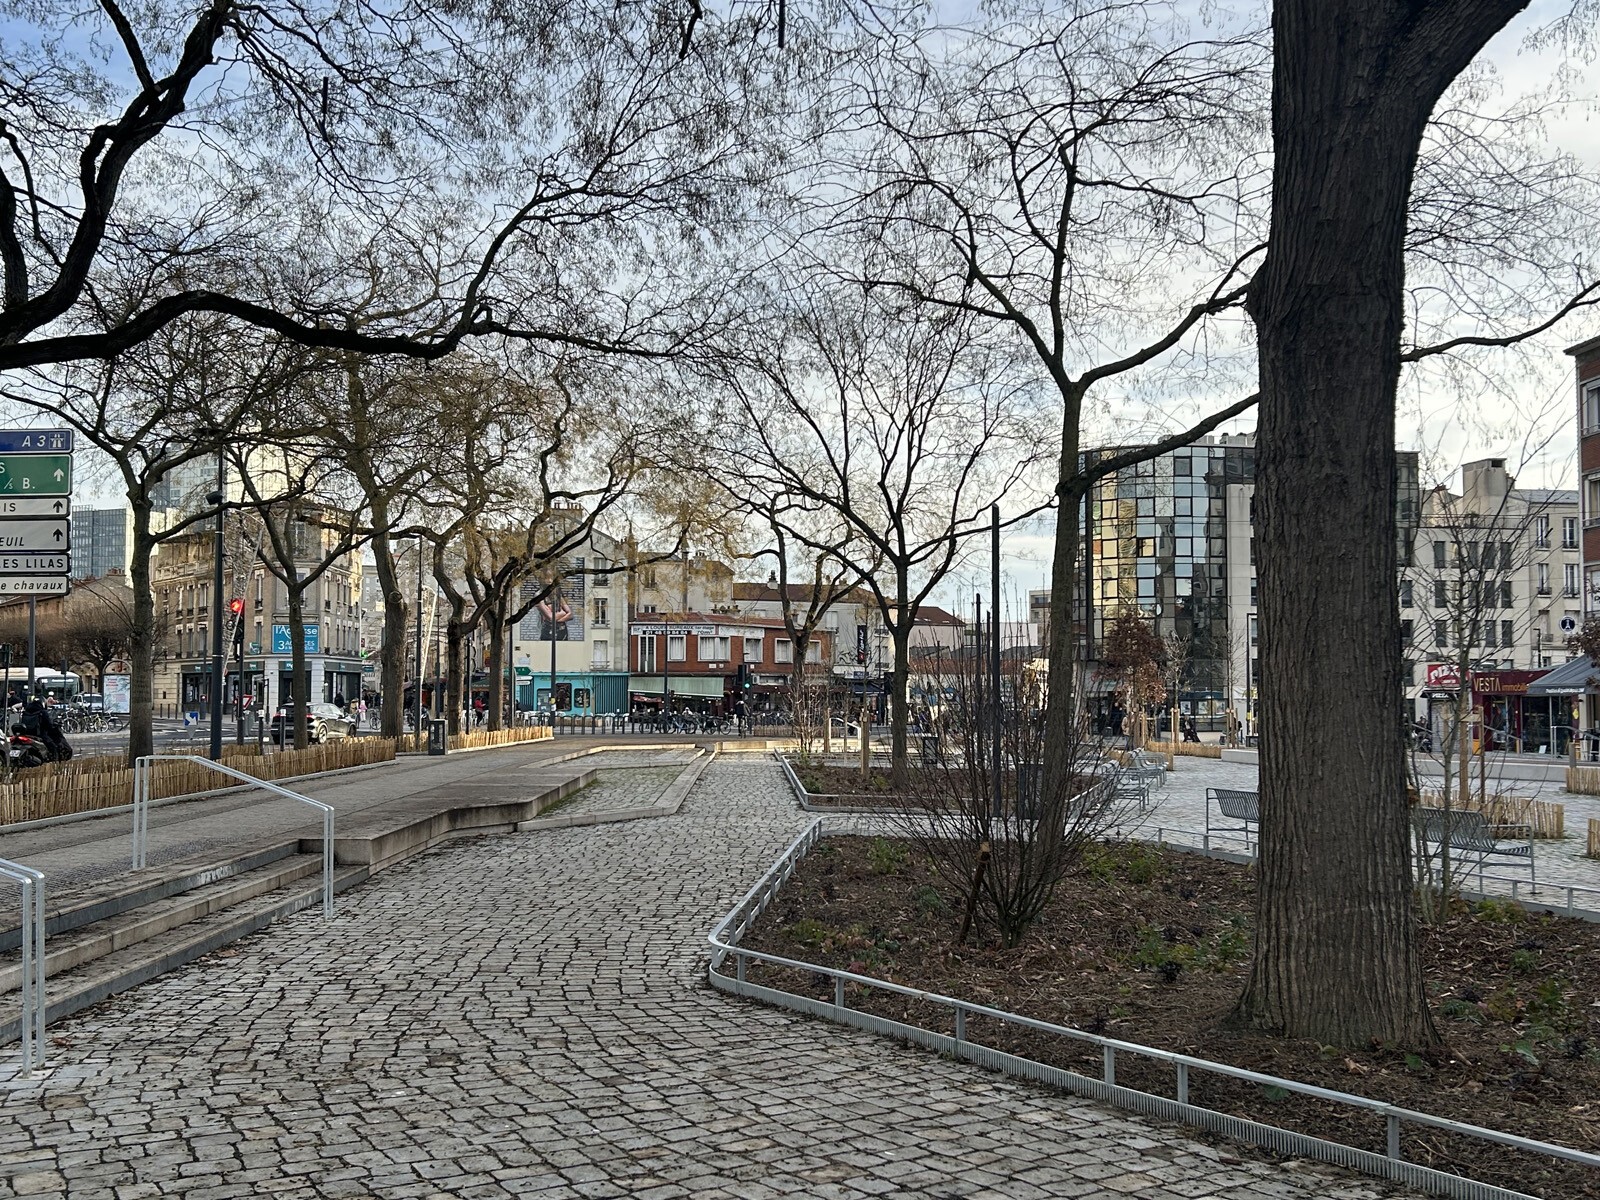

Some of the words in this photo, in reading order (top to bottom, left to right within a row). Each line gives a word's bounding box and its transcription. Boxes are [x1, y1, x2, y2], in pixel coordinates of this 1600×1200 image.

[22, 435, 31, 447] A
[37, 435, 46, 447] 3
[26, 558, 64, 568] LILAS
[14, 580, 63, 590] chavaux
[277, 640, 285, 650] 3
[1473, 677, 1501, 692] VESTA
